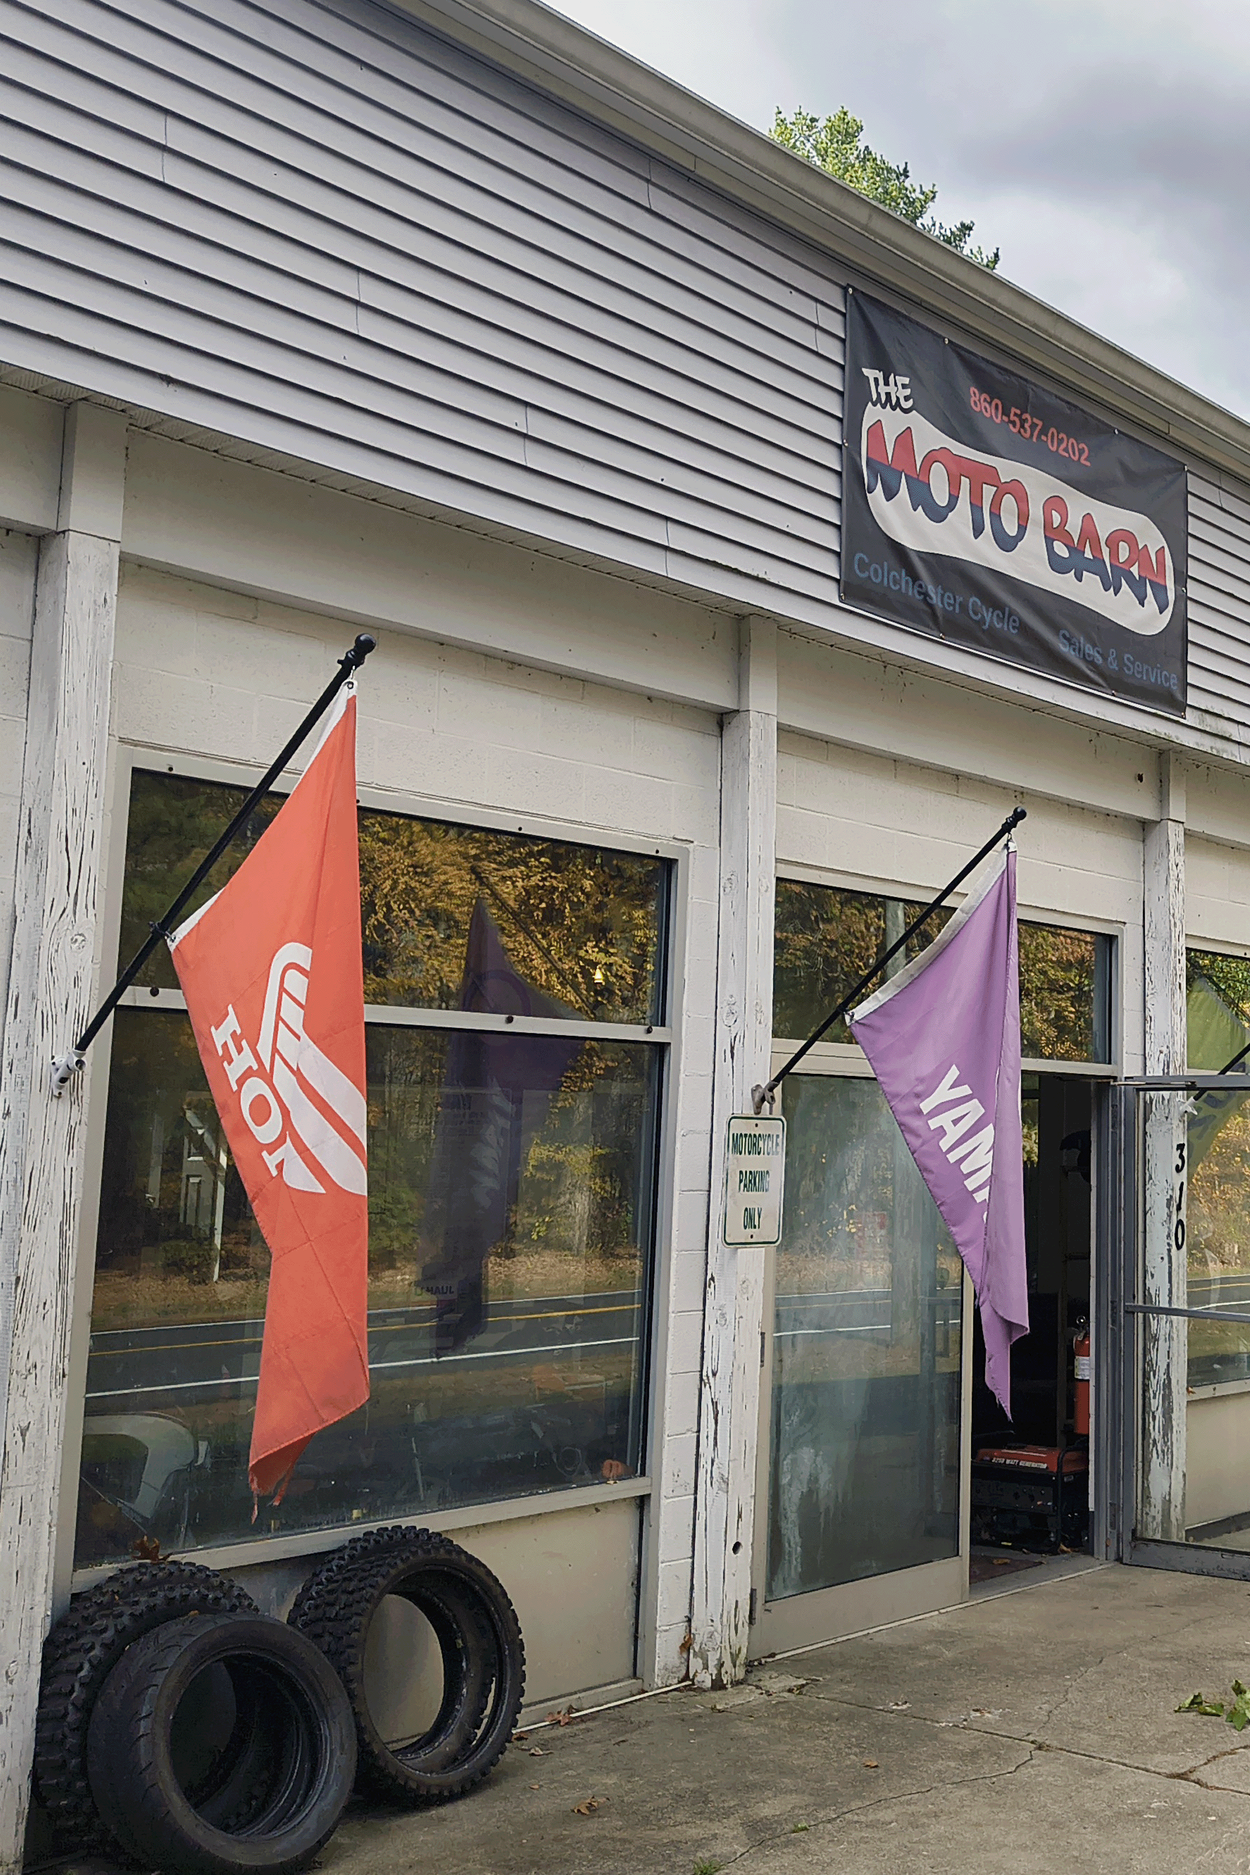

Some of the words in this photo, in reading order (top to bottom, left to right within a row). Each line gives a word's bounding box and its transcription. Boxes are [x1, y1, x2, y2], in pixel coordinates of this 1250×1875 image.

[862, 367, 914, 410] THE
[969, 386, 1091, 467] 860-537-0202
[866, 418, 1030, 553] MOTO
[1043, 494, 1171, 615] BARN
[853, 552, 964, 614] Colchester
[967, 596, 1020, 635] Cycle
[1058, 629, 1103, 665] Sales
[1107, 649, 1119, 671] &
[1123, 653, 1179, 691] Service
[731, 1132, 780, 1156] MOTORCYCLE
[738, 1169, 770, 1193] PARKING
[743, 1206, 763, 1230] ONLY
